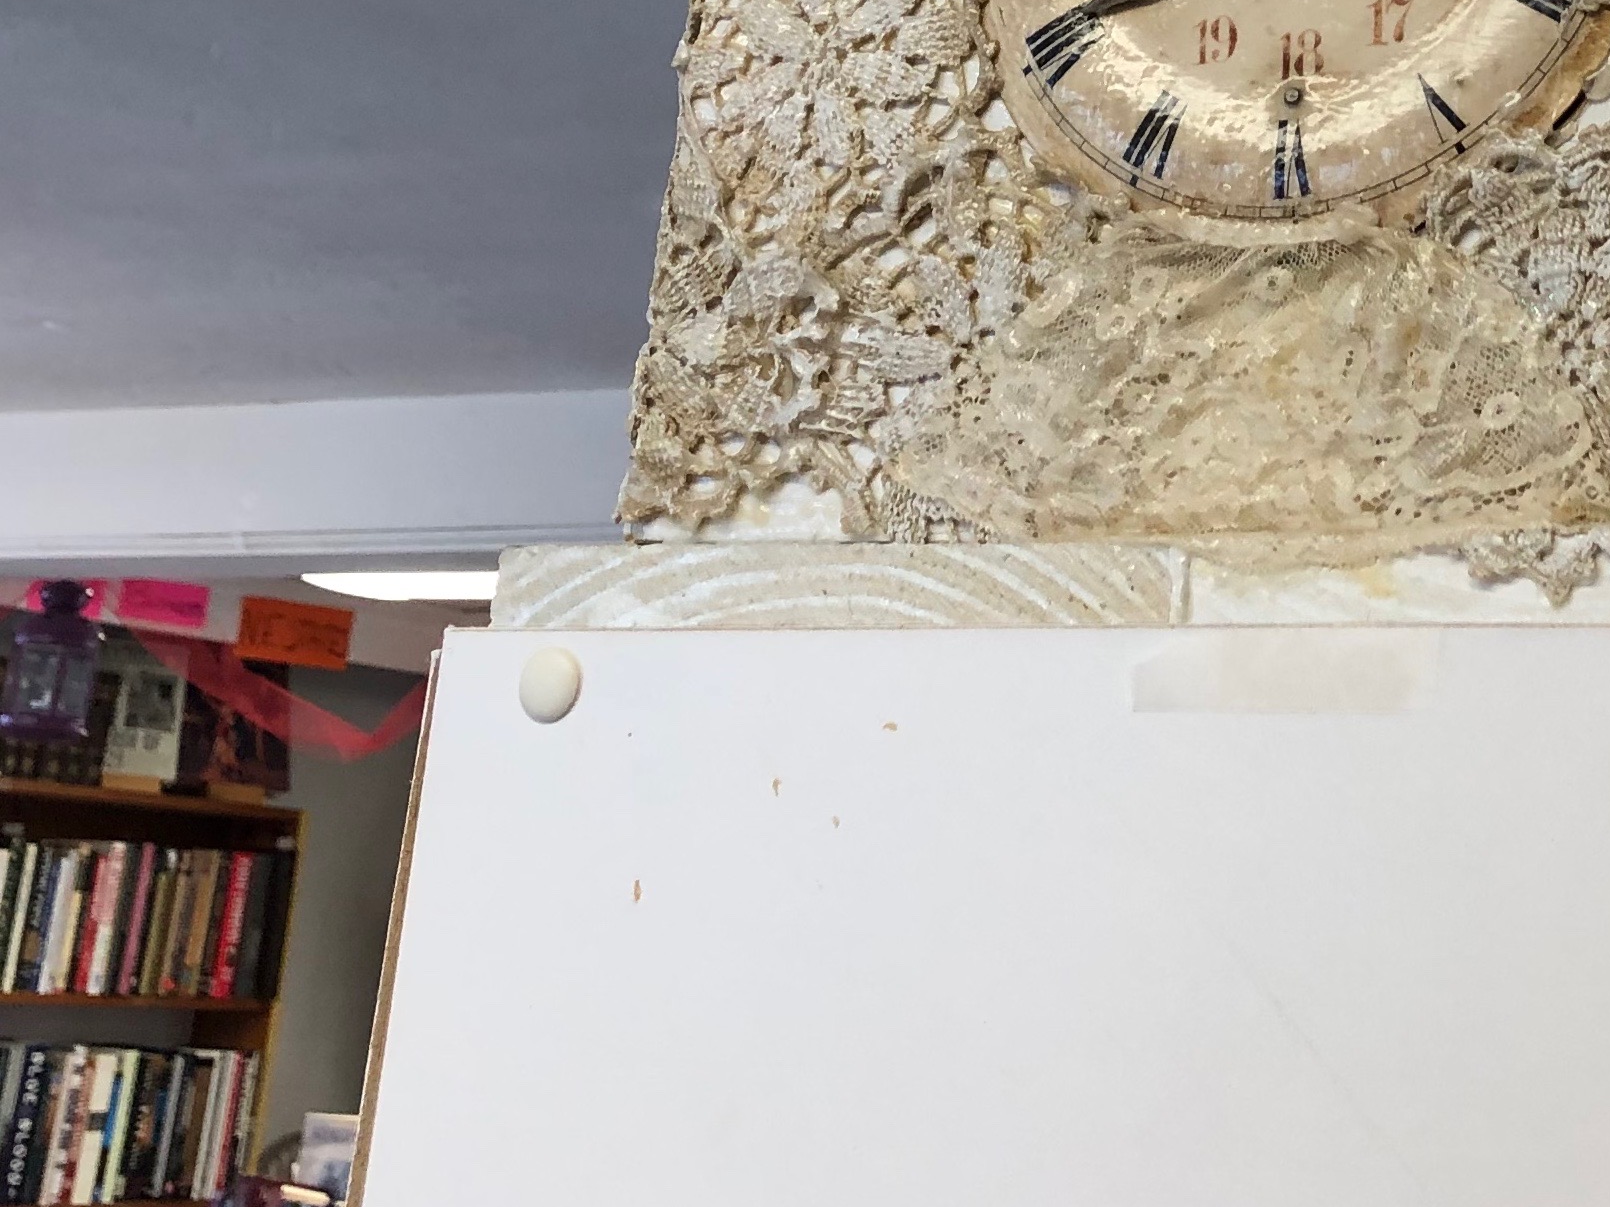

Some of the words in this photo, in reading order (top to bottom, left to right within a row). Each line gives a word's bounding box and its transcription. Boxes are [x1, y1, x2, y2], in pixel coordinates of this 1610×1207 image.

[1192, 14, 1239, 66] 19
[1280, 28, 1325, 80] 18
[1417, 73, 1471, 143] V
